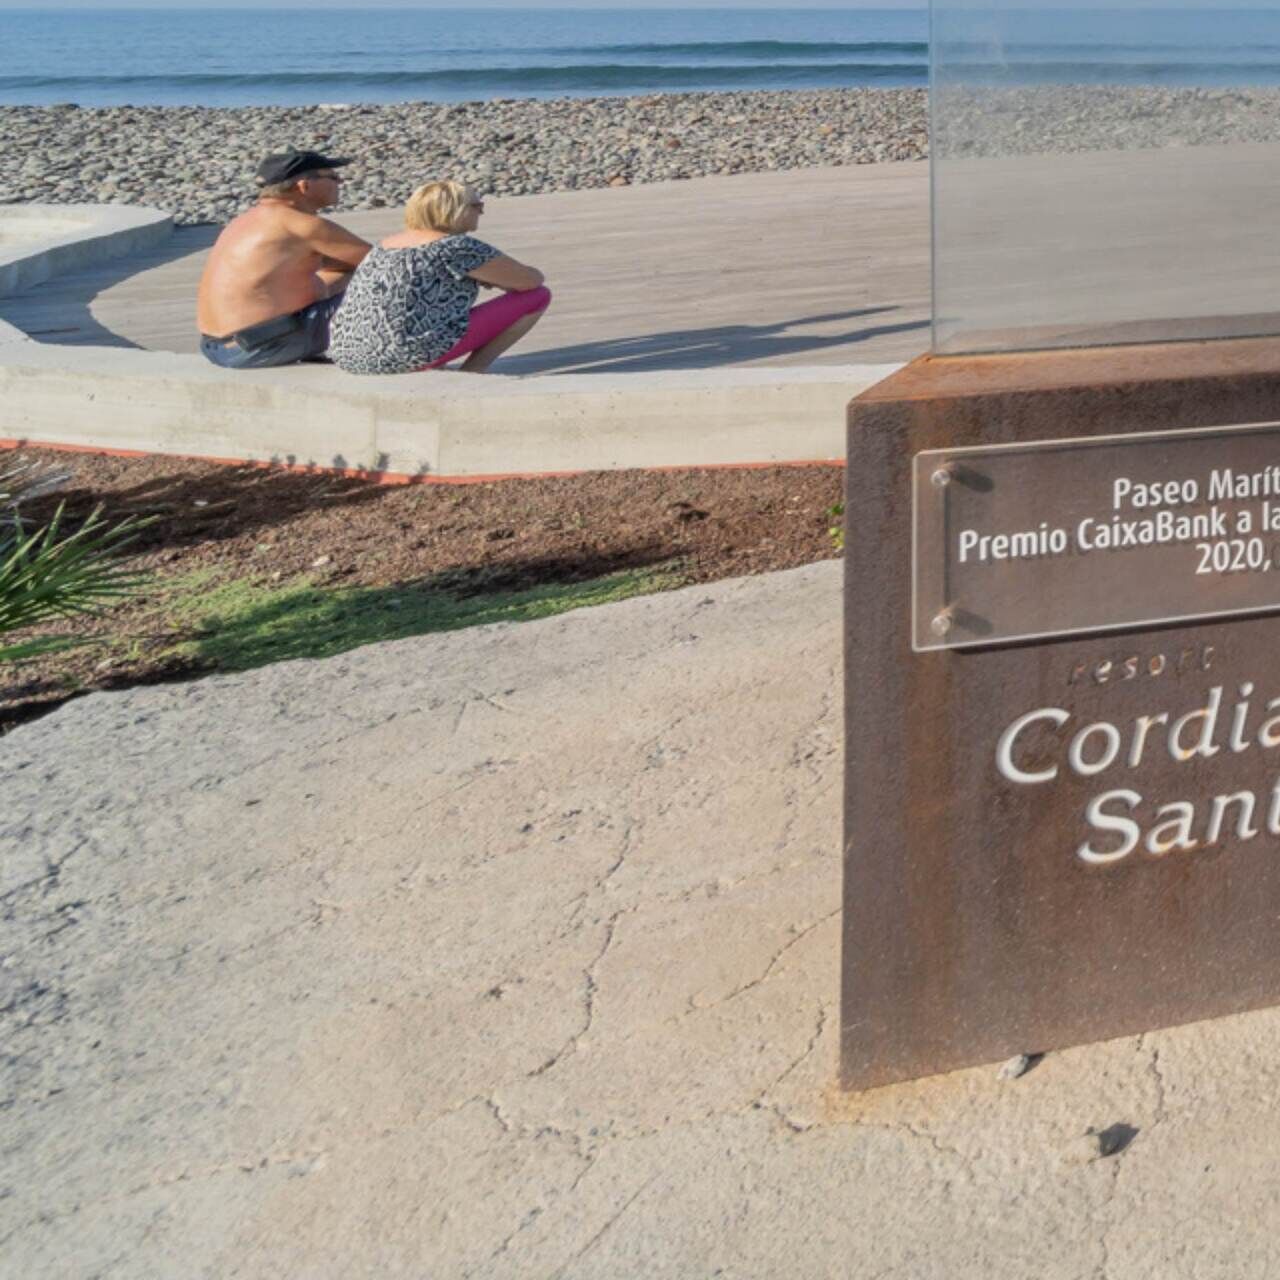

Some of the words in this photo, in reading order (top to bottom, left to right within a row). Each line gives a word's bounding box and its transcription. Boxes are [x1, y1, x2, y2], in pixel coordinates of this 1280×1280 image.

[1113, 477, 1197, 509] Paseo
[959, 523, 1067, 563] Premio
[1078, 509, 1226, 549] CaixaBank
[1236, 510, 1251, 533] a
[1195, 539, 1271, 574] 2020,
